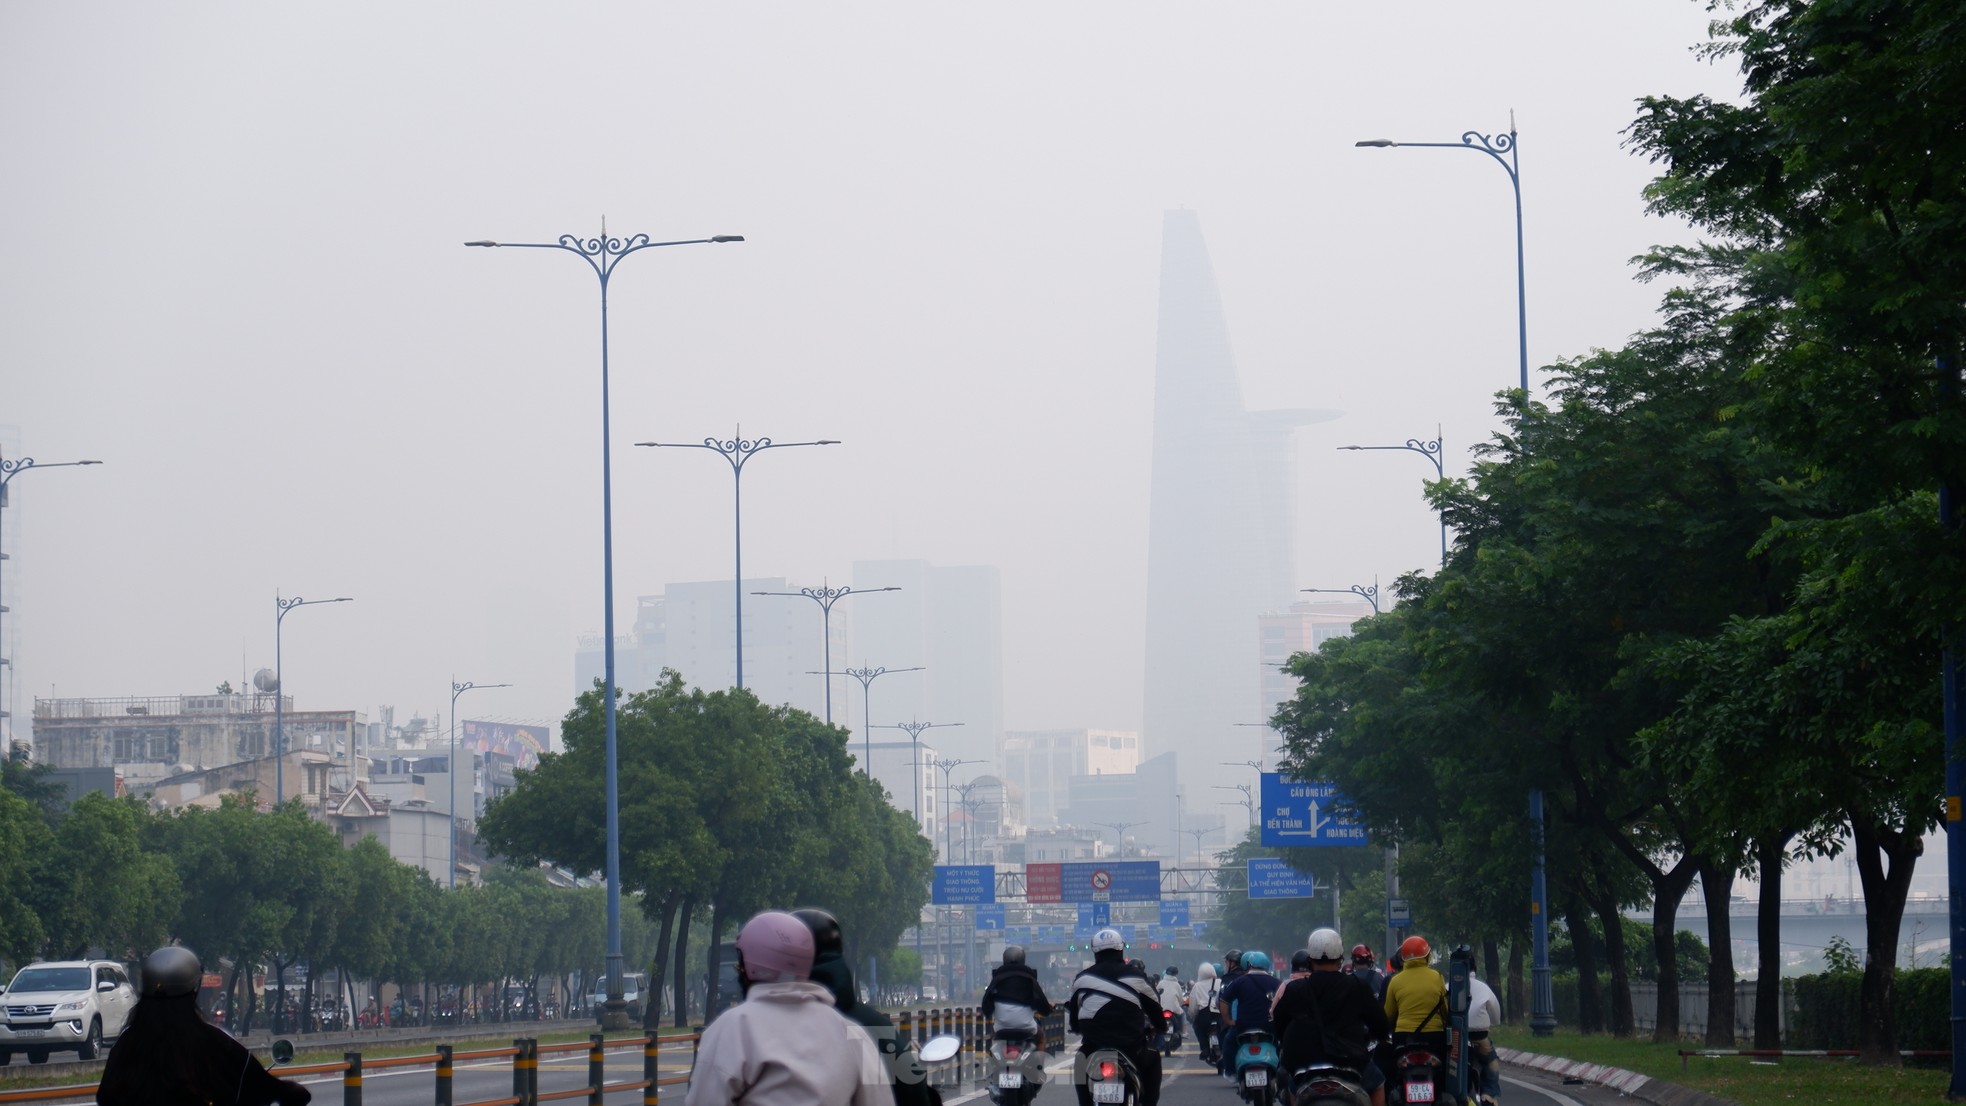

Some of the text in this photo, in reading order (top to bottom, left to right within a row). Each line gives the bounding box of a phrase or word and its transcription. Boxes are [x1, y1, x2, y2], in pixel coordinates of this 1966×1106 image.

[576, 633, 633, 647] Vietinank
[1290, 786, 1304, 798] CẦU
[1305, 786, 1319, 798] ÔNG
[1276, 807, 1290, 818] CHỢ
[1267, 817, 1303, 829] BẾN THÀNH
[1326, 827, 1348, 839] HOÀNG
[1278, 887, 1298, 895] THÔNG
